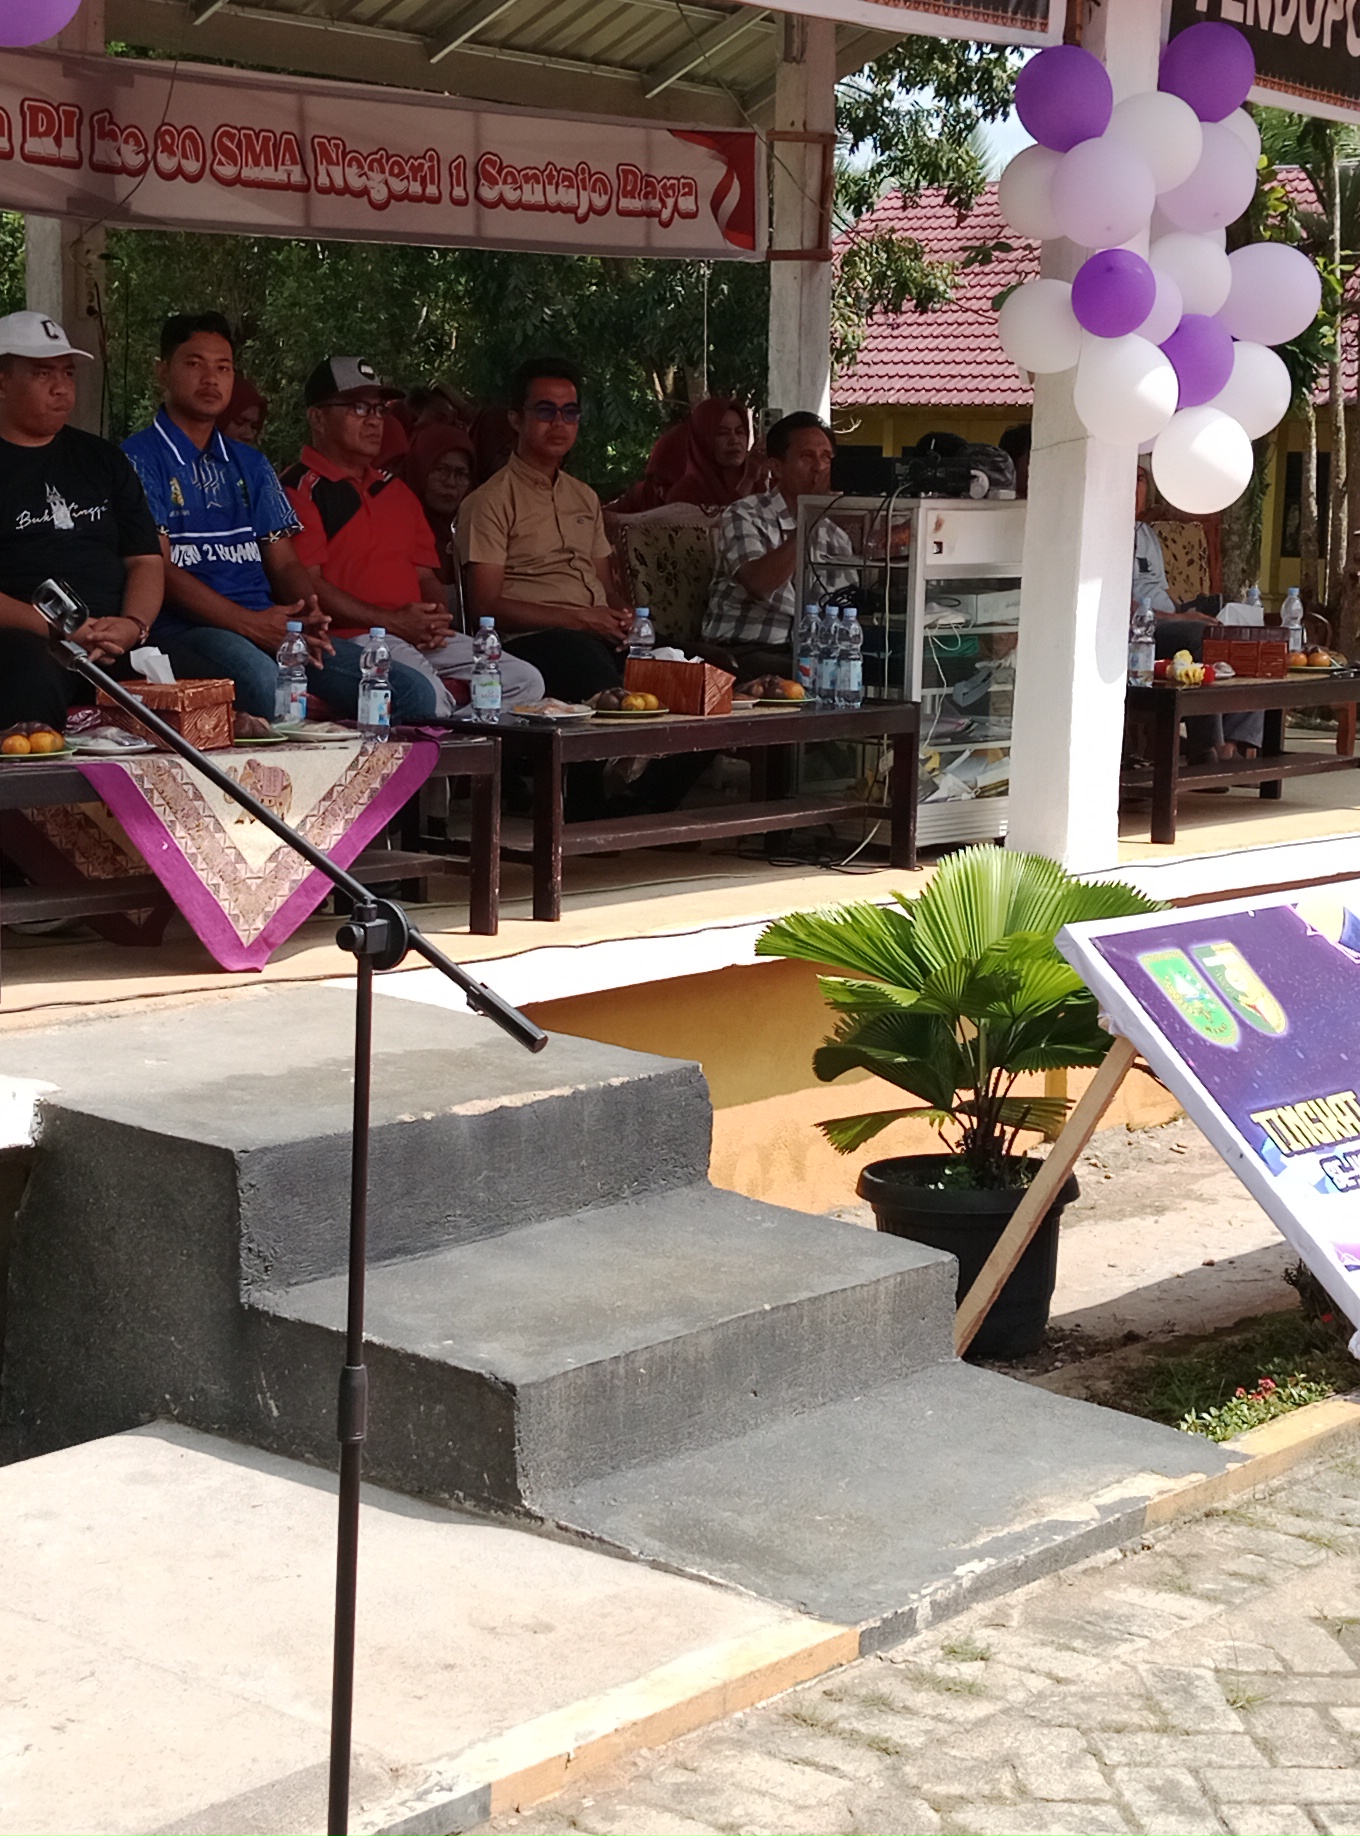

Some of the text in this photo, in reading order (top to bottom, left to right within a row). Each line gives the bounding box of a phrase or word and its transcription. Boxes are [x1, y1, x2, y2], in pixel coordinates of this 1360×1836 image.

[20, 97, 83, 169] RI
[89, 109, 148, 177] ke
[153, 122, 205, 183] 80
[211, 125, 311, 192] SMA
[312, 135, 442, 211] Negeri
[449, 155, 467, 206] 1
[476, 151, 612, 224] Sentajo
[616, 163, 699, 228] Raya
[202, 544, 217, 561] 2
